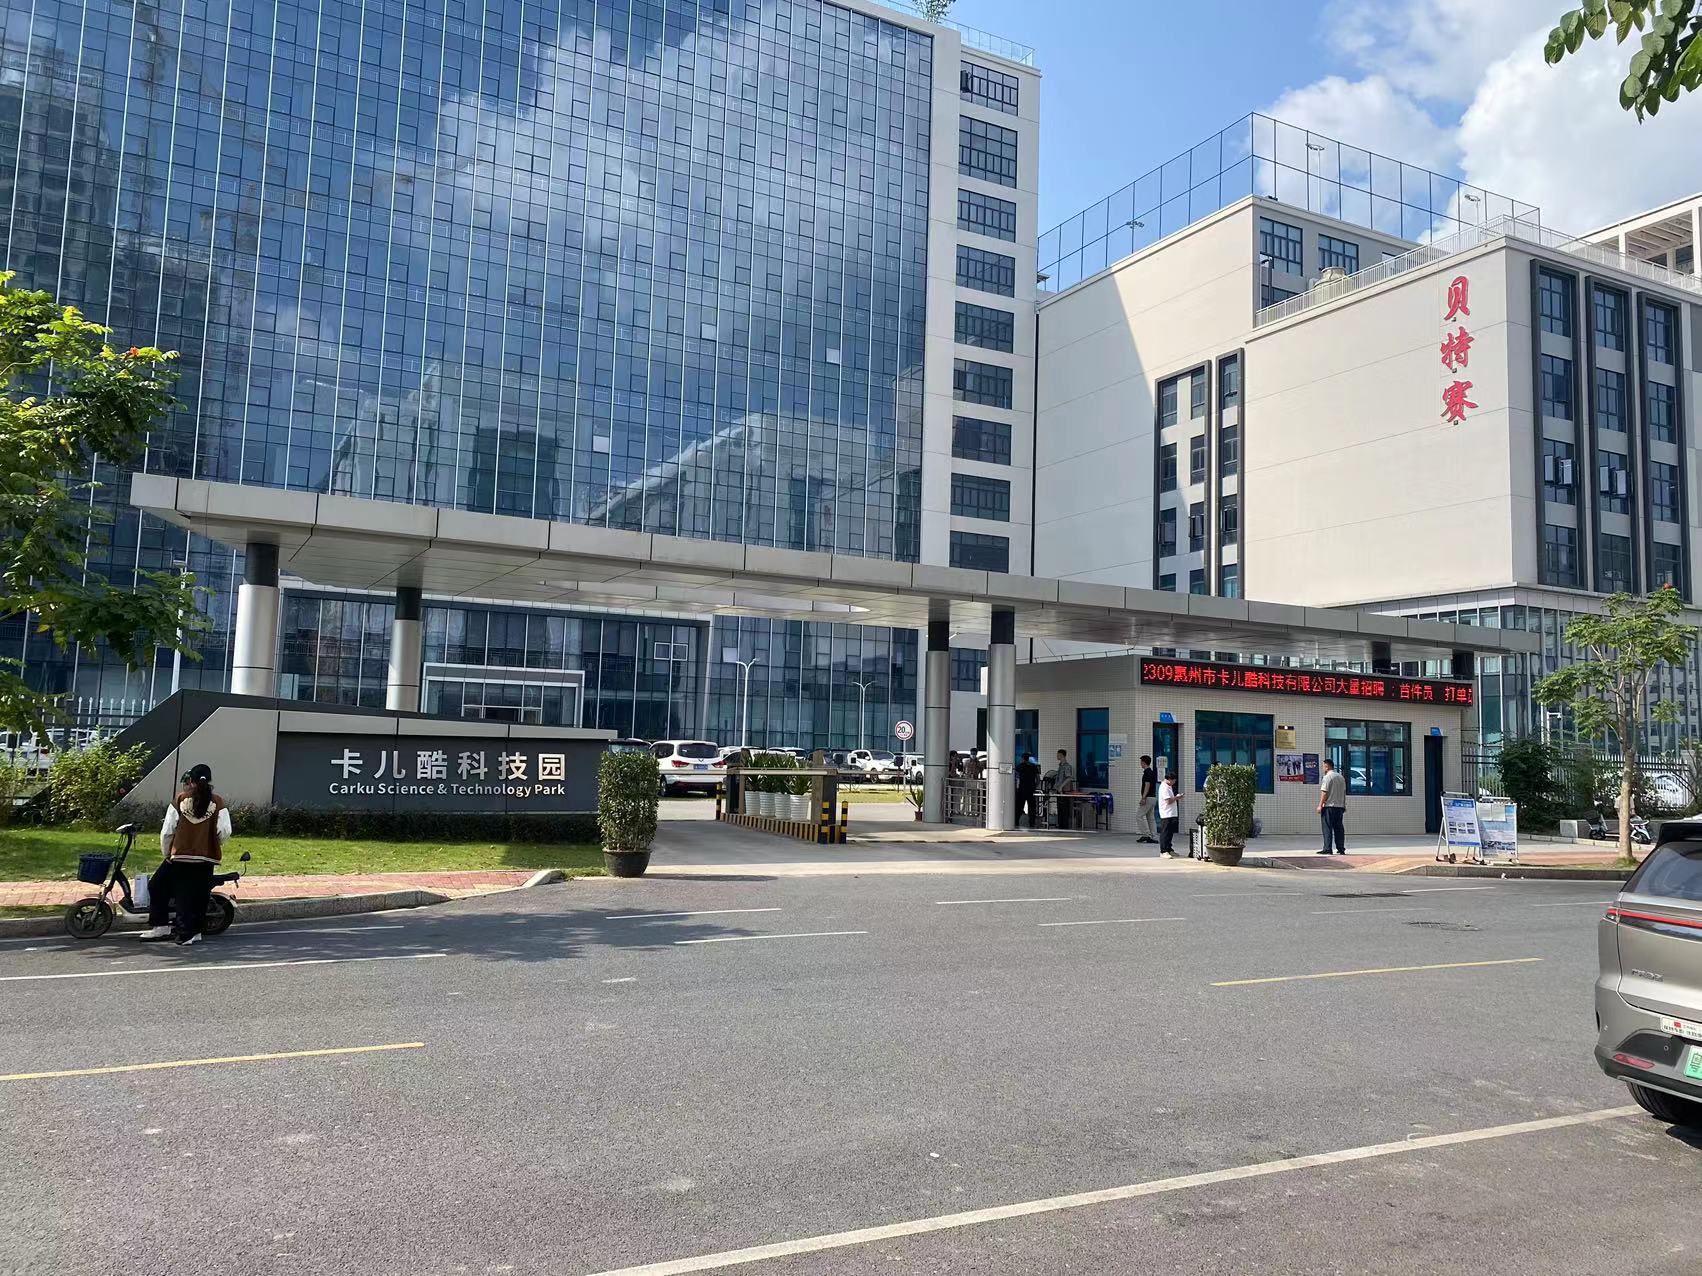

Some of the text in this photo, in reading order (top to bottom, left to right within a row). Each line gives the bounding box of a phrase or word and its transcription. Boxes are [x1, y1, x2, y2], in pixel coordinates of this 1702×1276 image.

[331, 748, 566, 781] 卡儿酷科技园
[329, 782, 565, 798] Carku Science & Technology Park
